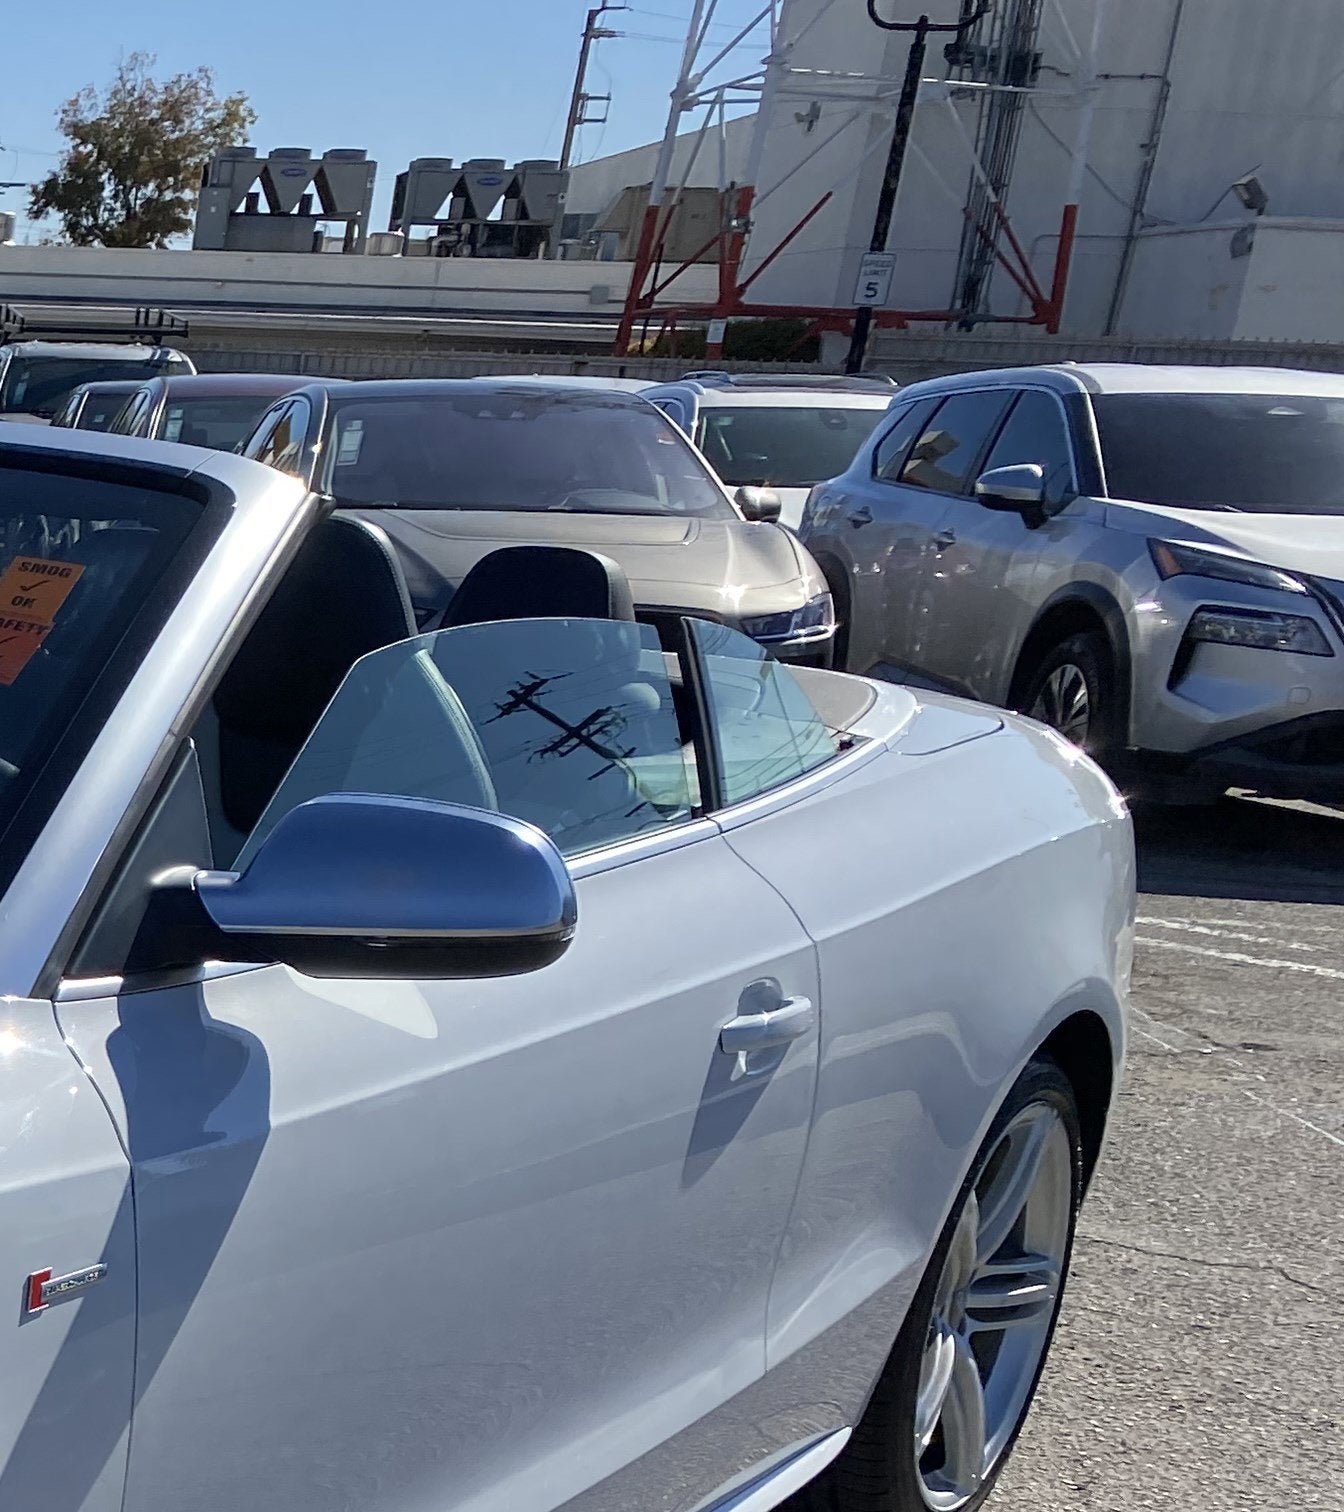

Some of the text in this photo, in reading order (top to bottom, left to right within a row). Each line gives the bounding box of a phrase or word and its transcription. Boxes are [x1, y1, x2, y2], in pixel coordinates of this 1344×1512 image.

[863, 259, 893, 268] SPEED
[863, 269, 888, 277] LIMIT
[864, 281, 879, 298] 5
[18, 561, 72, 579] SMOG
[11, 595, 37, 609] OK
